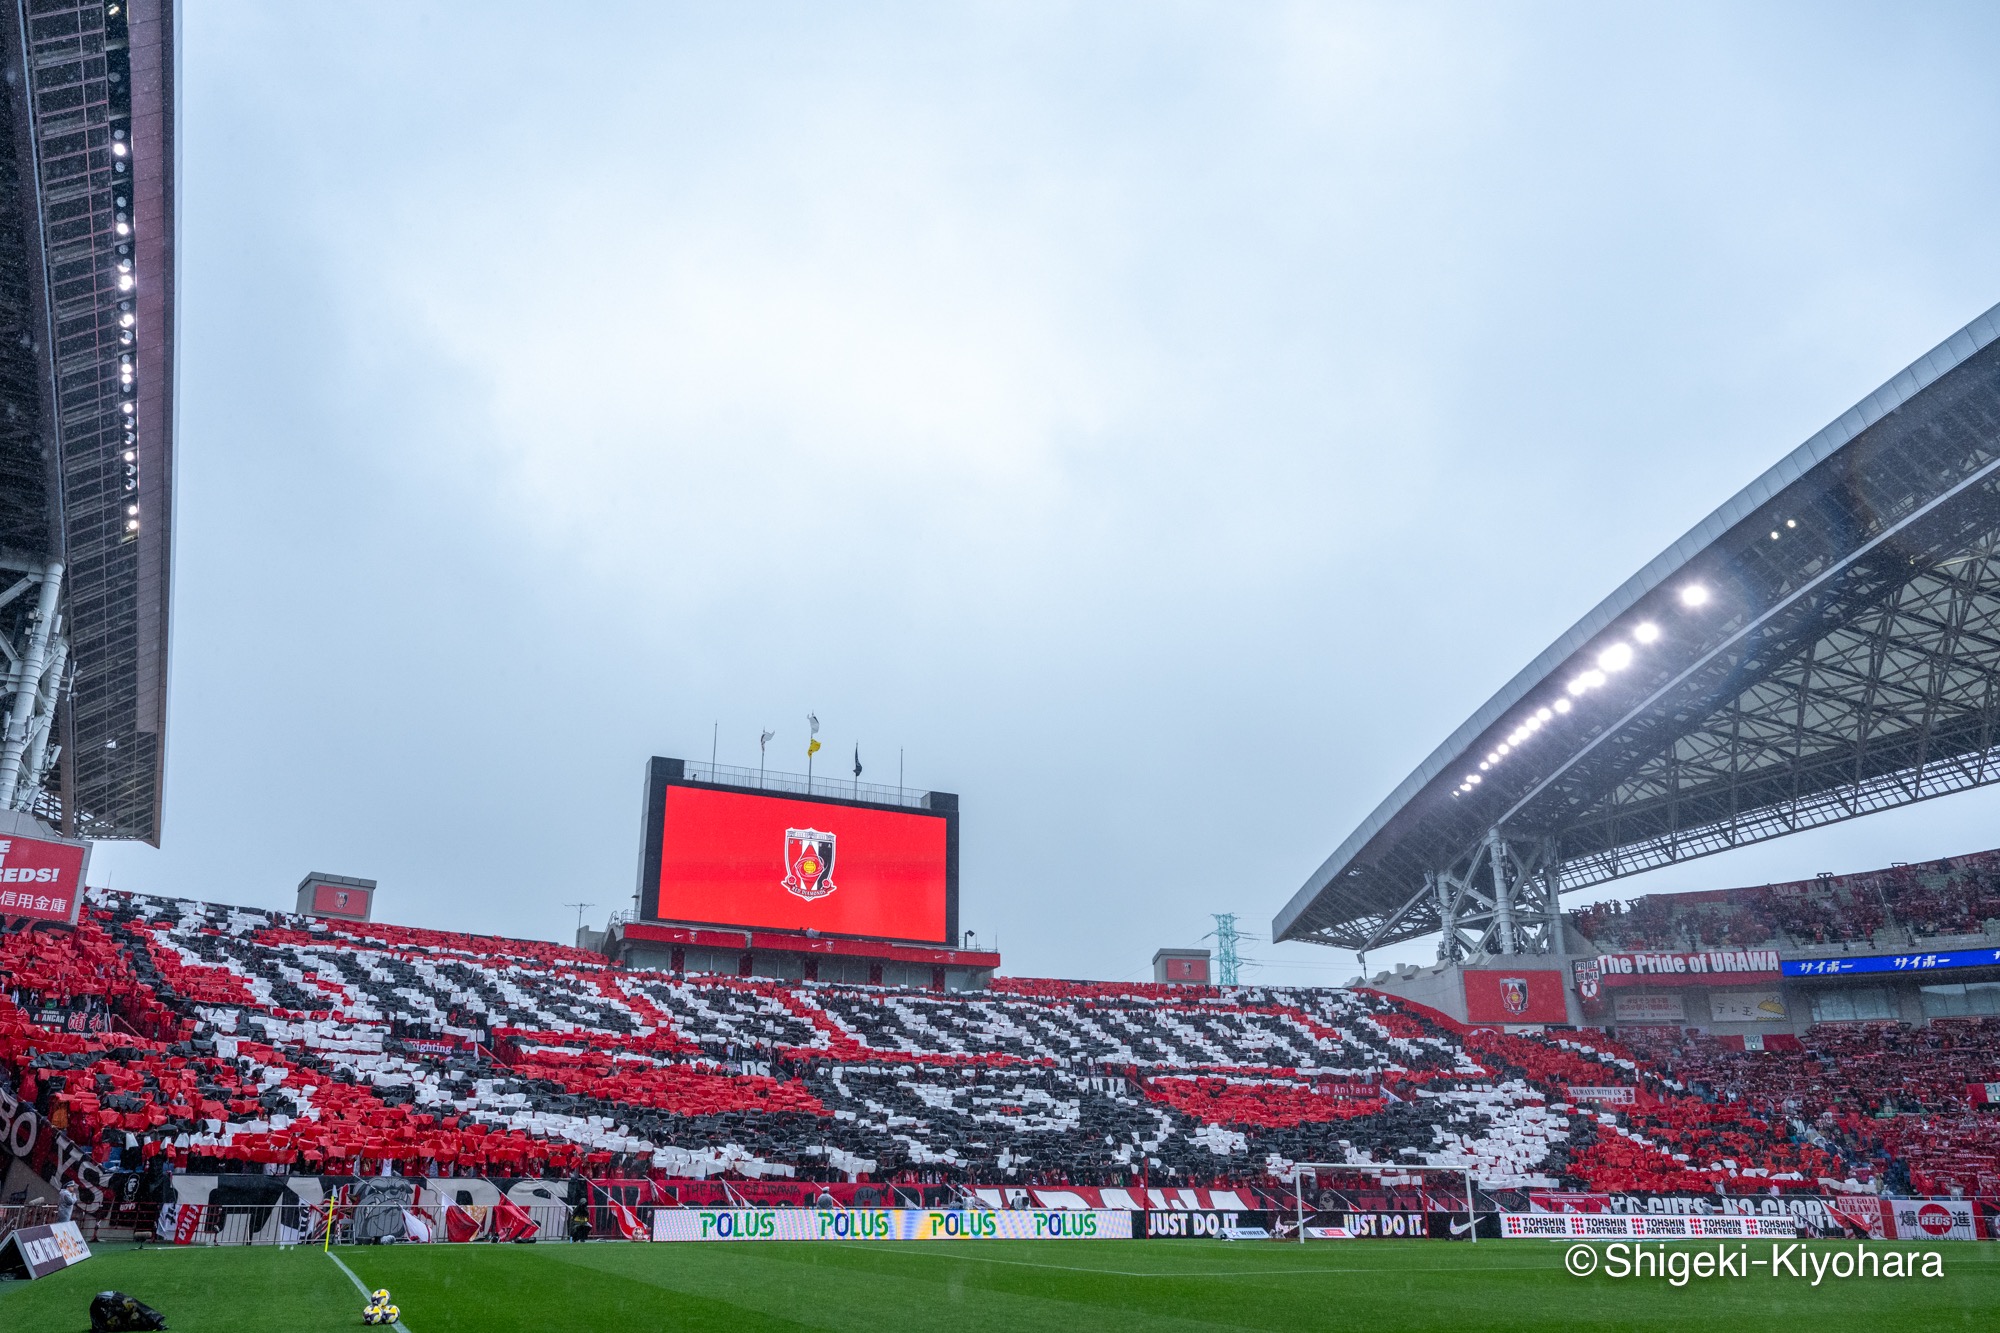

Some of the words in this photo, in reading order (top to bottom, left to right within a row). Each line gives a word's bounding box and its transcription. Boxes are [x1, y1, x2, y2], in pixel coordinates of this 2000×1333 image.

[1597, 954, 1633, 975] The
[1634, 953, 1687, 974] Pride
[1690, 953, 1709, 973] of
[1710, 951, 1779, 973] URAWA
[1800, 961, 1853, 974] サイボー
[1893, 955, 1950, 969] サイボー
[1744, 1035, 1760, 1043] 307
[1985, 1084, 2000, 1094] 21
[684, 1184, 707, 1197] THE
[763, 1184, 801, 1196] URAWA
[1840, 1205, 1879, 1213] URAWA
[928, 1212, 997, 1237] POLUS
[1033, 1212, 1098, 1237] POLUS
[1148, 1213, 1189, 1236] JUST
[1193, 1213, 1219, 1236] DO
[1522, 1217, 1566, 1228] TOHSHIN
[1585, 1218, 1628, 1228] TOHSHIN
[1644, 1219, 1685, 1228] TOHSHIN
[1702, 1219, 1741, 1229] TOHSHIN
[1921, 1216, 1952, 1227] REDS
[1952, 1211, 1971, 1227] 進
[700, 1212, 776, 1238] POLUS
[817, 1212, 890, 1238] POLUS
[1343, 1214, 1377, 1236] JUST
[1381, 1215, 1406, 1236] DO
[1239, 1229, 1266, 1237] WINNER
[1523, 1226, 1567, 1236] PARTNERS
[1586, 1227, 1628, 1236] PARTNERS
[1645, 1227, 1687, 1236] PARTNERS
[1703, 1227, 1743, 1236] PARTNERS
